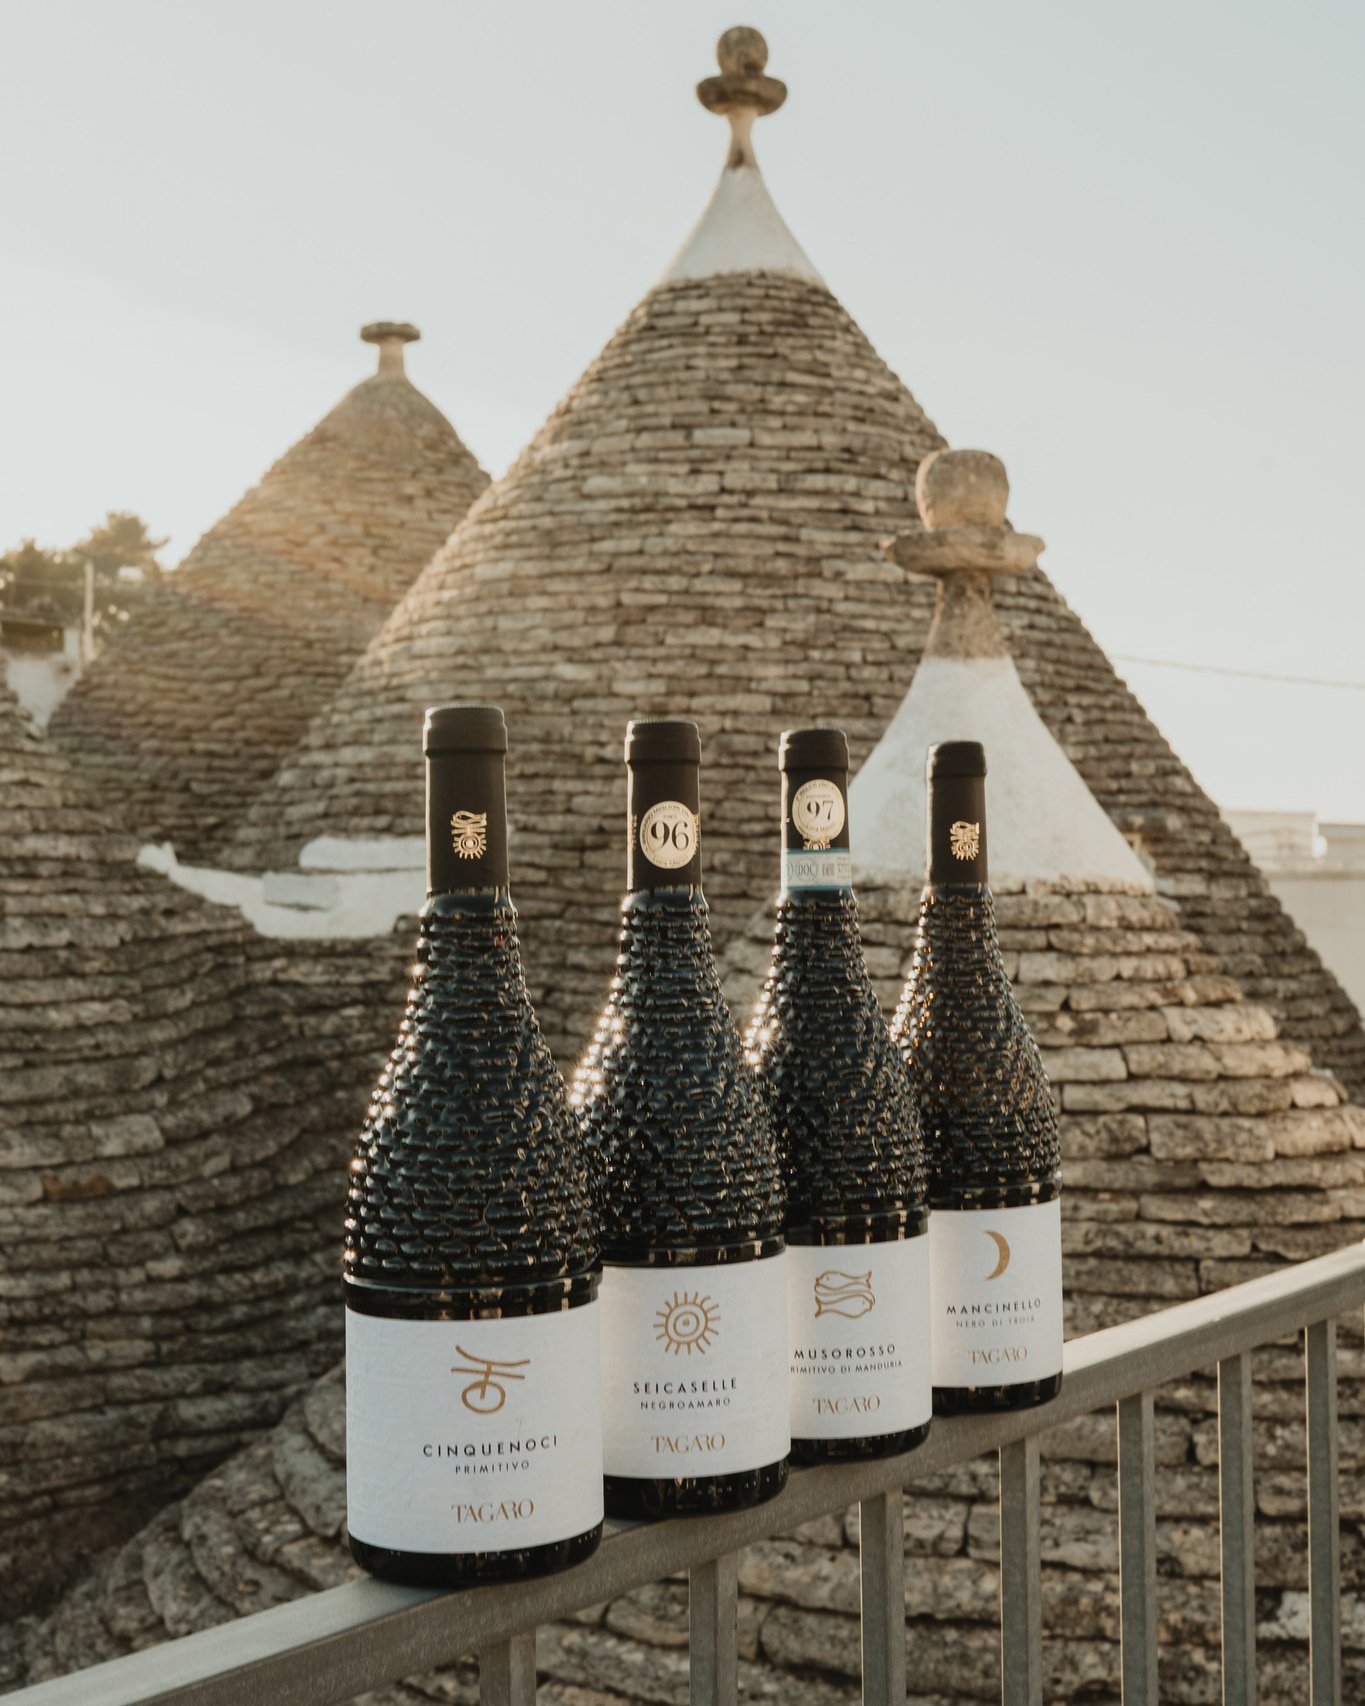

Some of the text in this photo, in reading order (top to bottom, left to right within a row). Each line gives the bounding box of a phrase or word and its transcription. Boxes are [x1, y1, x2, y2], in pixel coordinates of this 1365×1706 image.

[806, 801, 834, 821] 97
[651, 821, 689, 850] 96
[946, 1298, 1041, 1314] MANCINELLO
[956, 1319, 985, 1329] NERO
[794, 1343, 895, 1360] MUSOROSSO
[968, 1346, 1027, 1365] TAGARO
[790, 1359, 902, 1375] RIMITIVO DI MANDURIA
[633, 1377, 736, 1395] SEICASELLE
[640, 1396, 730, 1410] NEGROAMARO
[812, 1394, 881, 1415] TAGARO
[423, 1434, 557, 1457] CINQUENOCI
[650, 1432, 726, 1454] TAGARO
[455, 1460, 530, 1475] PRIMITIVO
[451, 1498, 535, 1524] TAGARO
